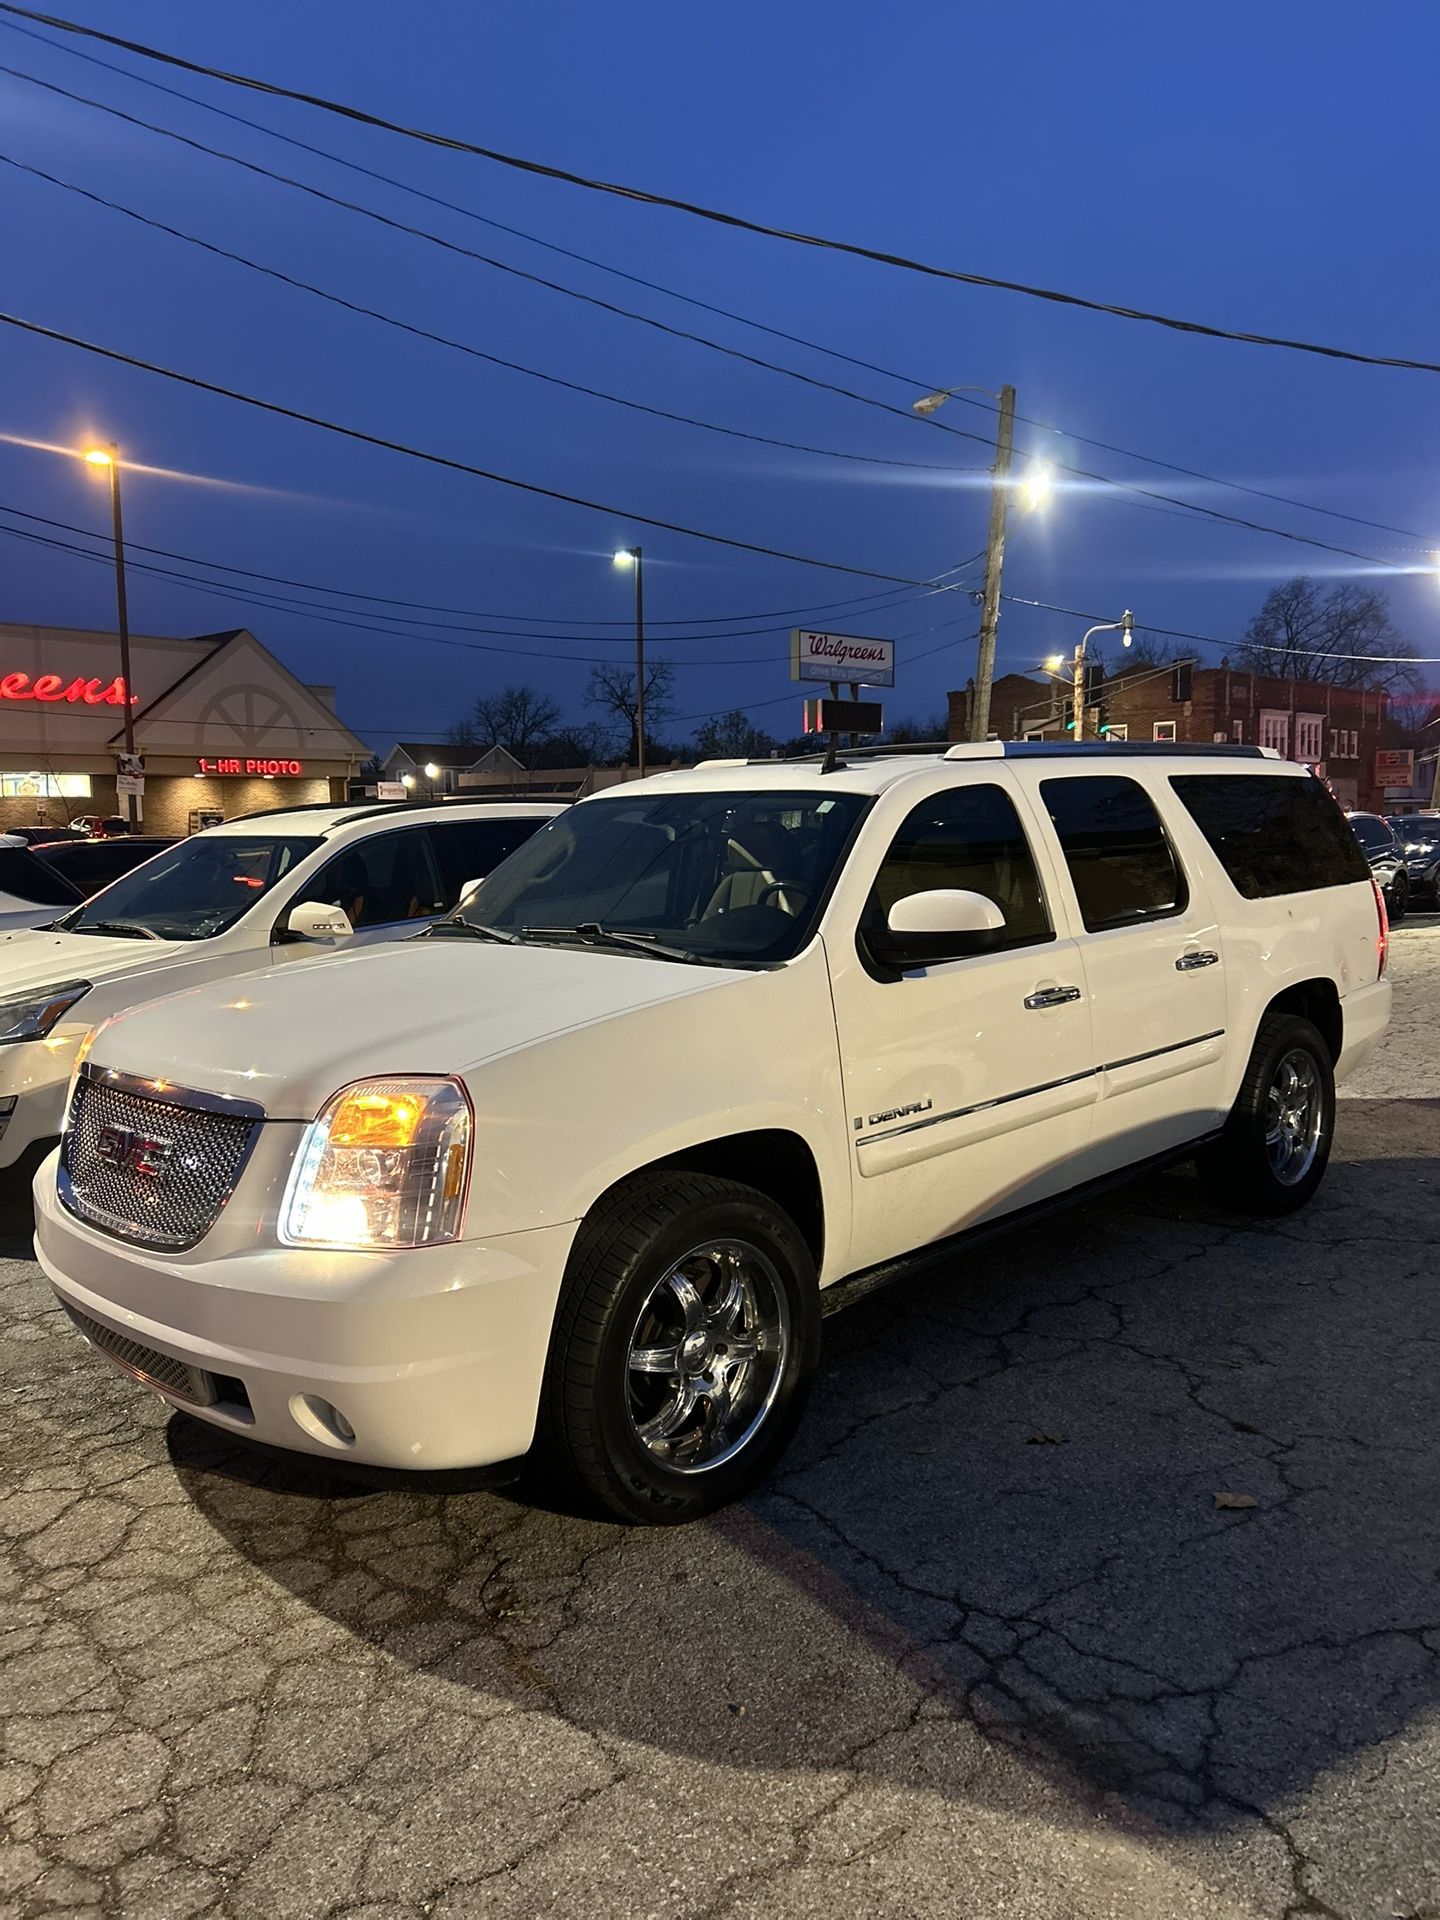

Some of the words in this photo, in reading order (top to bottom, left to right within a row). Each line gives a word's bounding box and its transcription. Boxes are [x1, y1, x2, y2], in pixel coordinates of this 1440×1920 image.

[808, 635, 886, 664] Walgreens
[199, 758, 240, 773] 1-HR
[246, 759, 301, 774] PHOTO
[868, 1098, 933, 1126] DENALI
[97, 1125, 174, 1176] GMC
